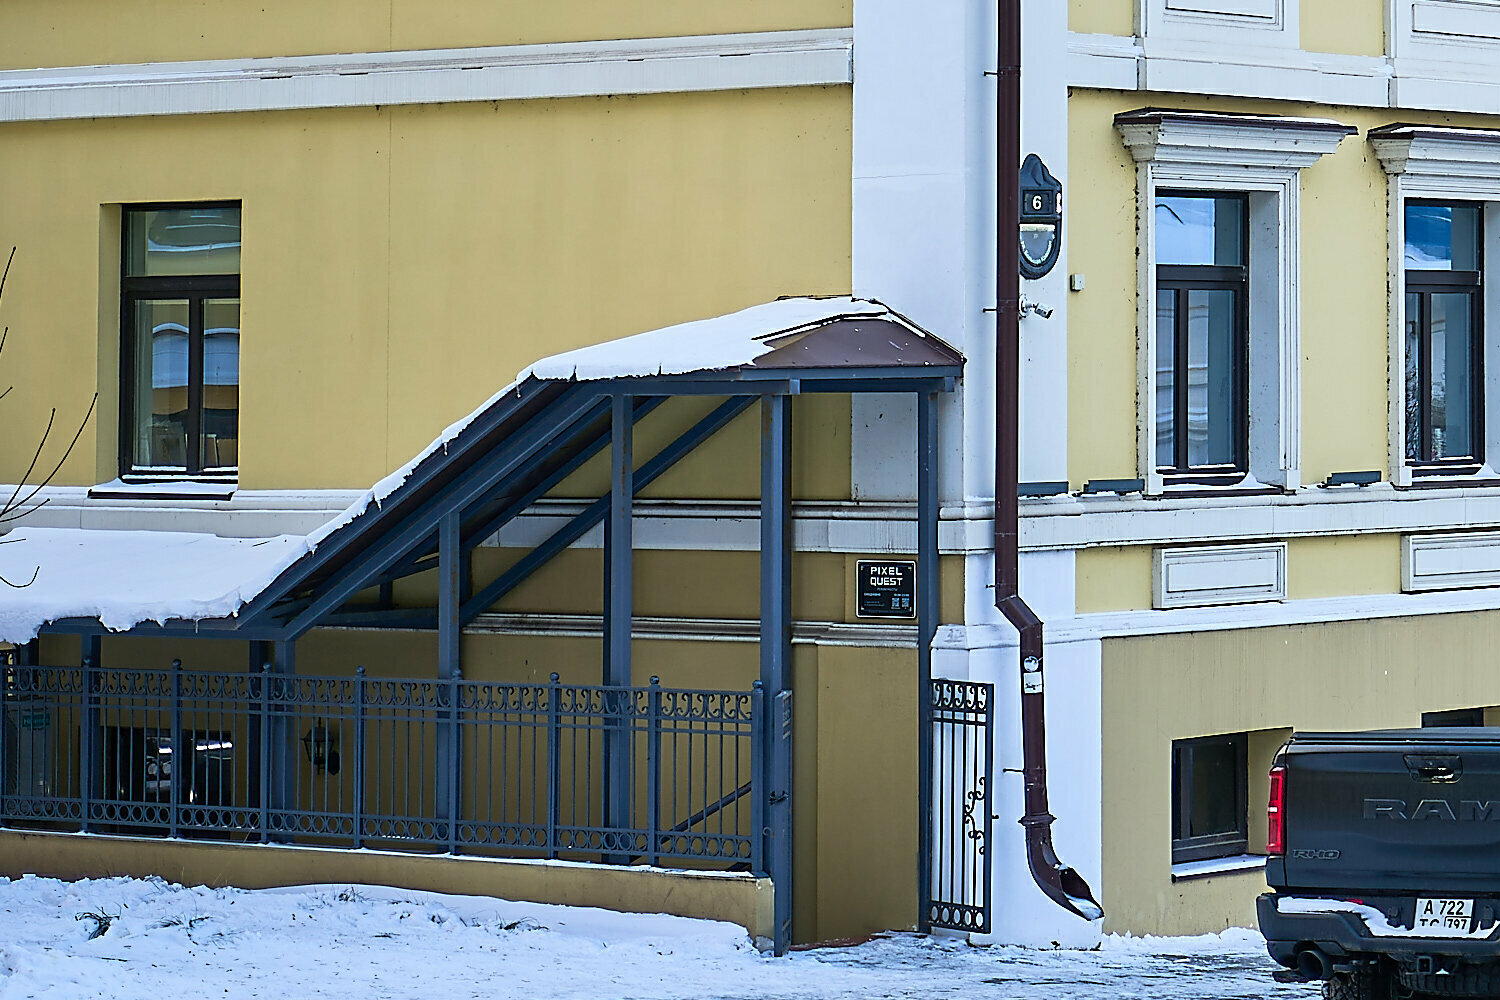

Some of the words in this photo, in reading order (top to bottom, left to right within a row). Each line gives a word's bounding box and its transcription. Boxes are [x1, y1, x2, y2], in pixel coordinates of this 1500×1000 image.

[1032, 195, 1043, 210] 6
[870, 566, 903, 576] PIXEL
[870, 576, 904, 587] QUEST
[1439, 900, 1465, 916] 722
[1446, 918, 1468, 930] 797
